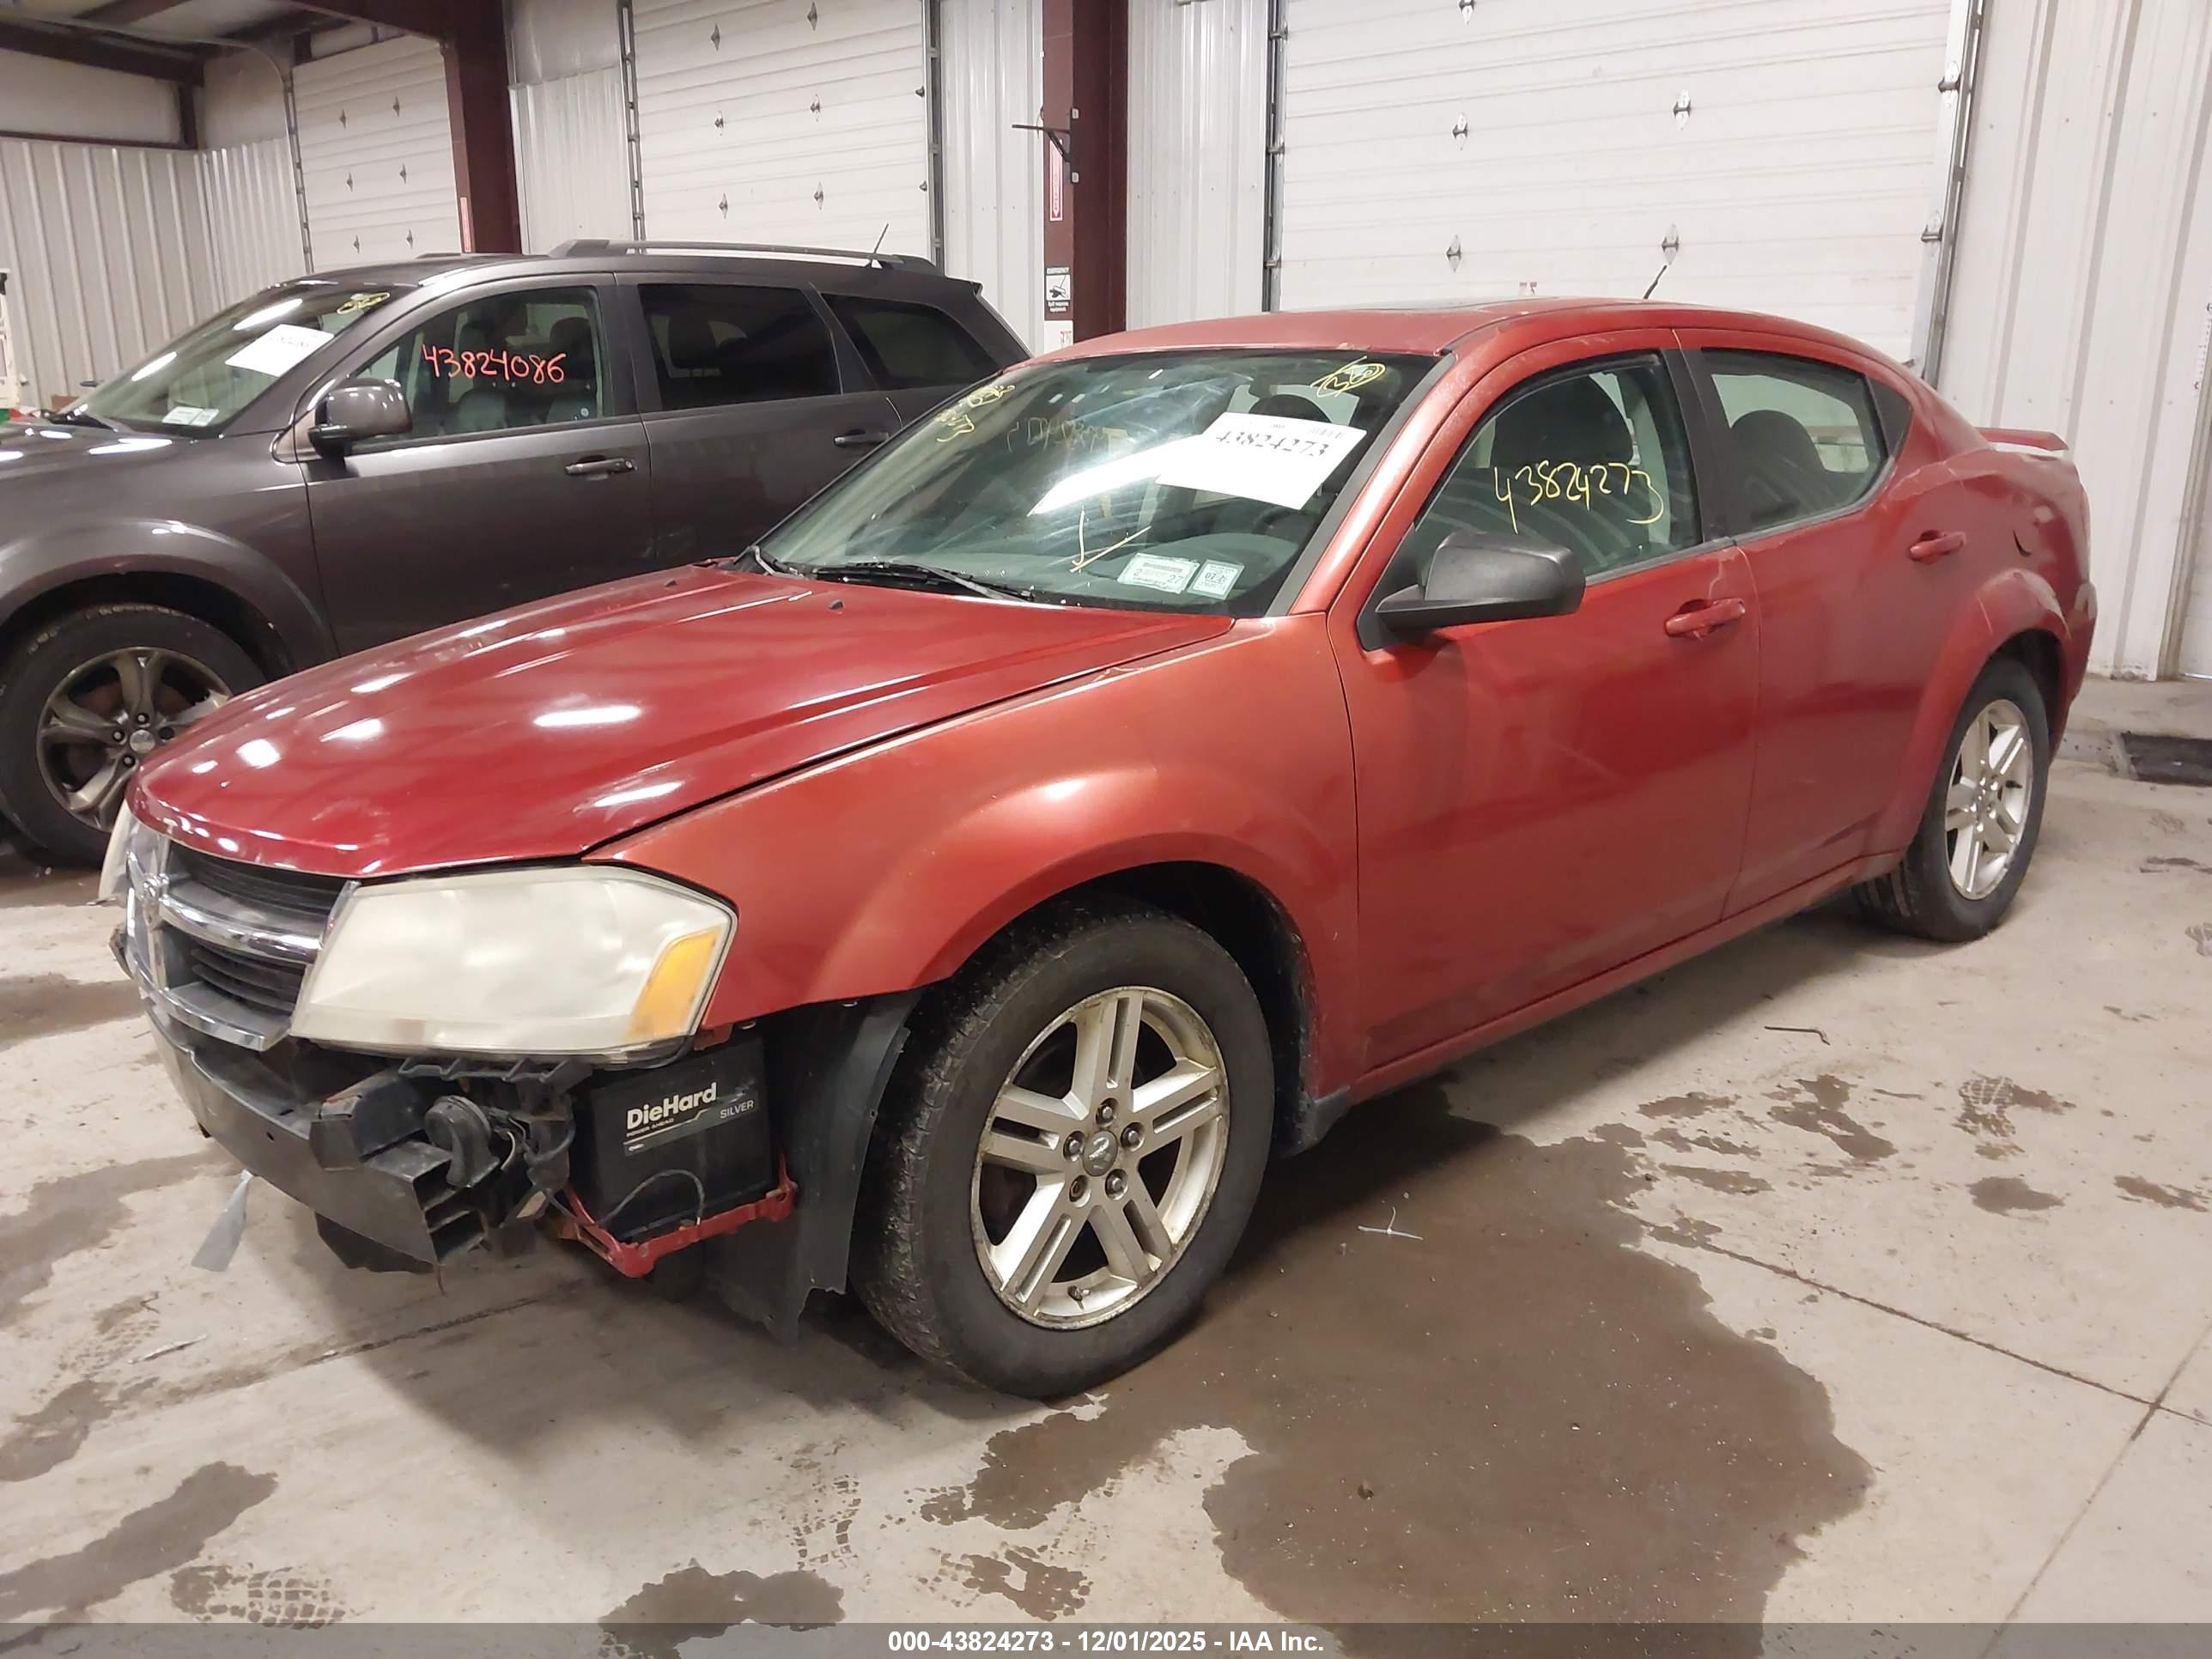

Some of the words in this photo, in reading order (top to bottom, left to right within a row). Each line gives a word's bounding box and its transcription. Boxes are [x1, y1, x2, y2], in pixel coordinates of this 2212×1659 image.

[422, 343, 567, 384] 43824086
[1494, 460, 1664, 535] 43824273
[626, 1082, 717, 1129] DieHard
[720, 1099, 755, 1119] SILVER
